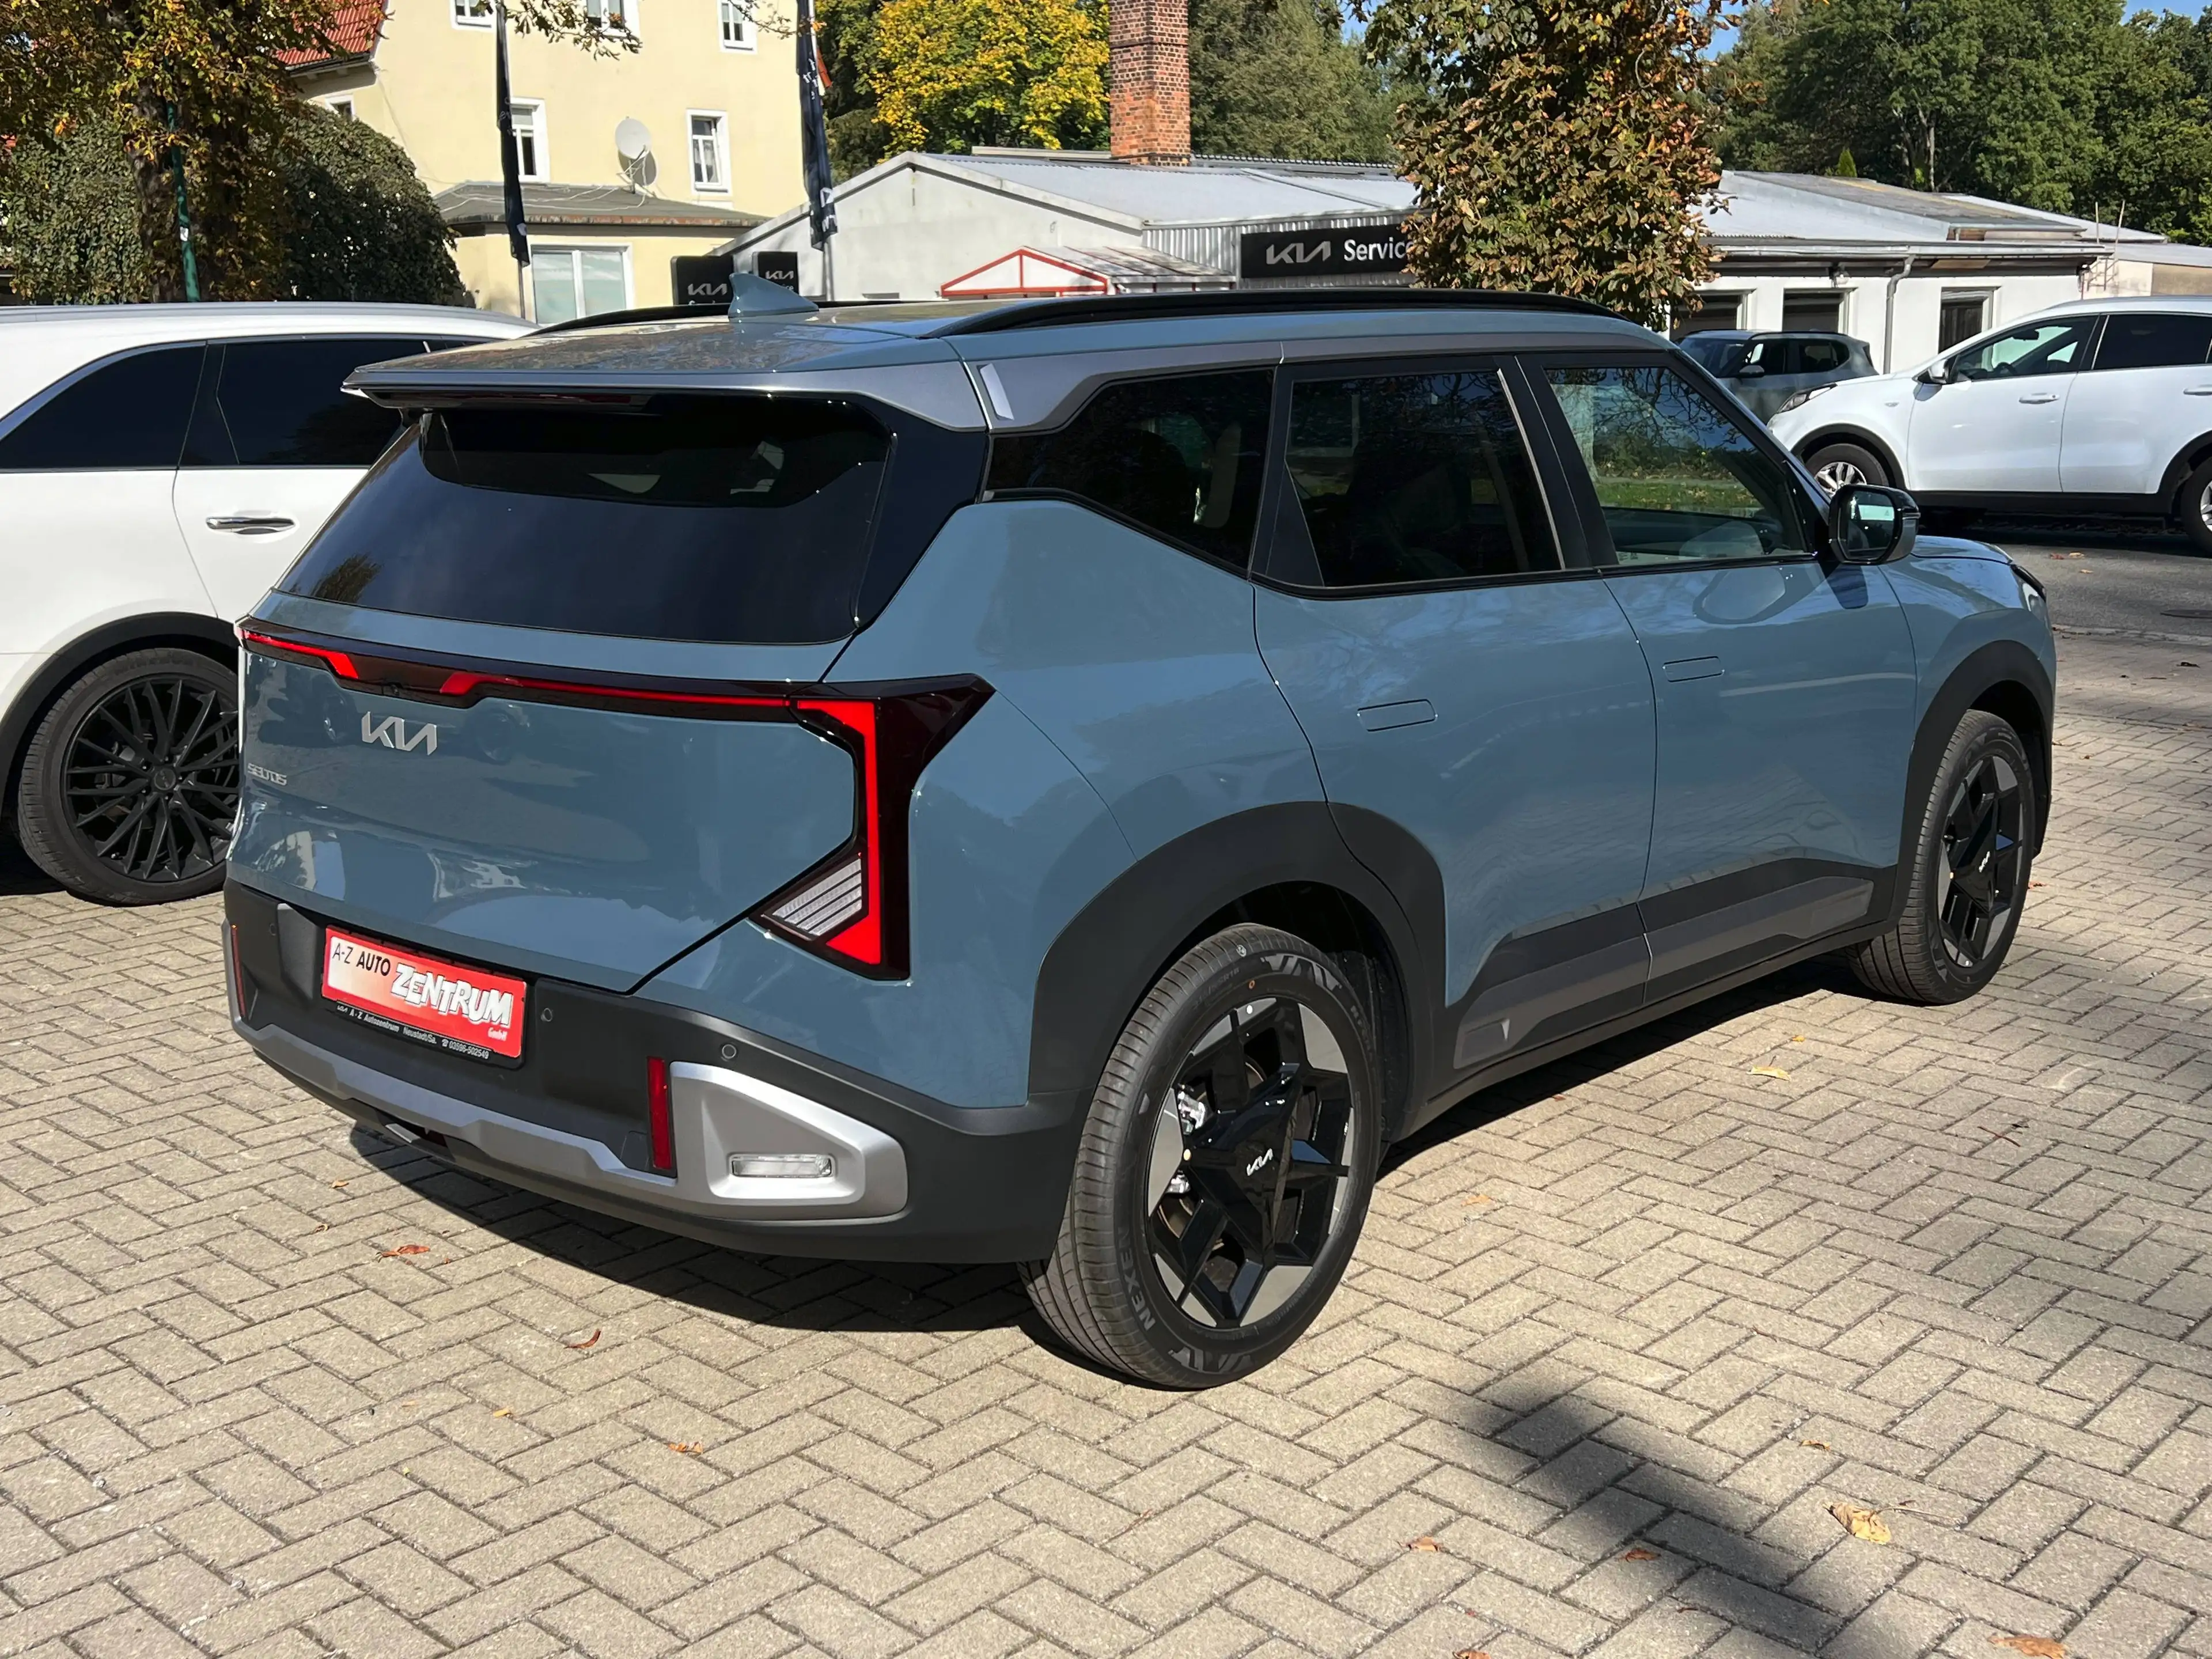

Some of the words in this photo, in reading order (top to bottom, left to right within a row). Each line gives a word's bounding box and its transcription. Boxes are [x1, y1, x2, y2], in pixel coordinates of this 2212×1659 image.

[1266, 241, 1331, 264] KIA
[766, 270, 794, 279] KIA
[687, 283, 728, 296] KIA
[361, 711, 437, 755] KIA
[356, 951, 391, 976] AUTO
[391, 962, 513, 1028] ZENTRUM
[1247, 1147, 1274, 1176] KIA
[1116, 1226, 1157, 1332] NEXEN
